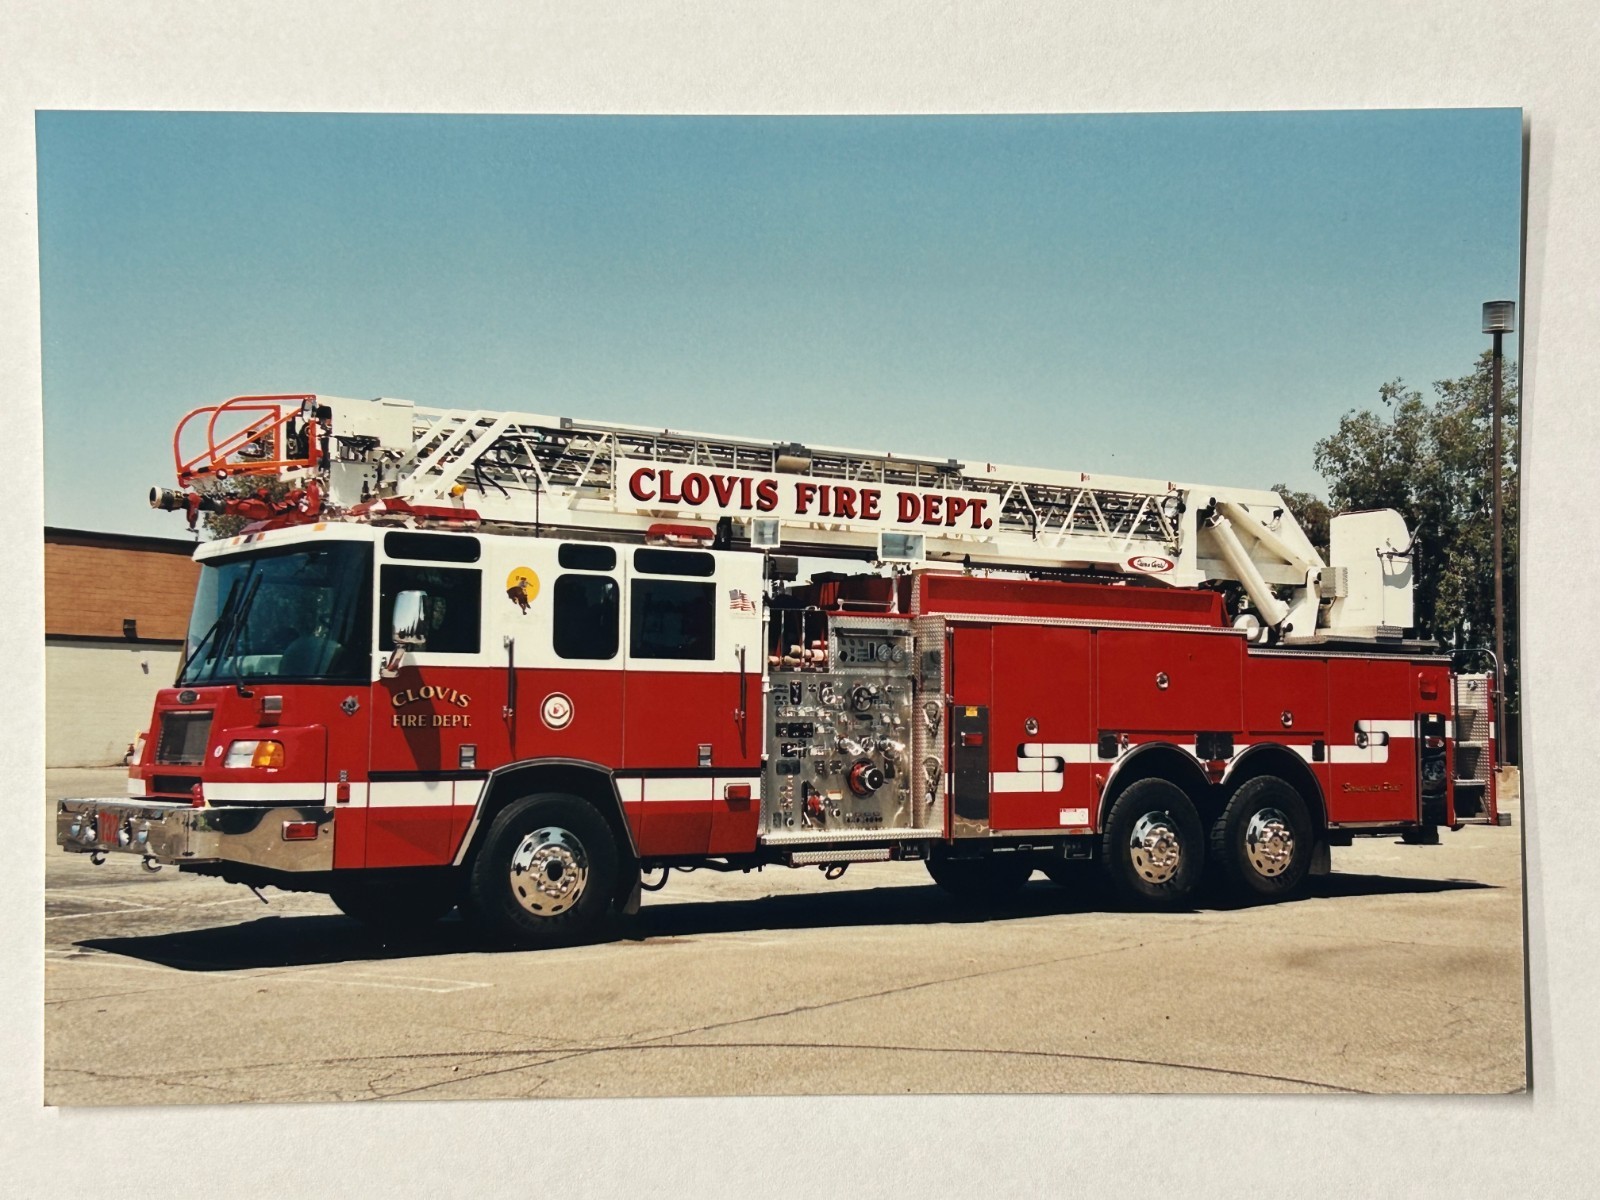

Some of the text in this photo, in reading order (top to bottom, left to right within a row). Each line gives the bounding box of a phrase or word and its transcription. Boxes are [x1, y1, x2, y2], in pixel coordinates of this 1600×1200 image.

[629, 467, 993, 530] CLOVIS FIRE DEPT.
[392, 685, 472, 708] CLOVIS
[392, 714, 472, 728] FIRE DEPT.
